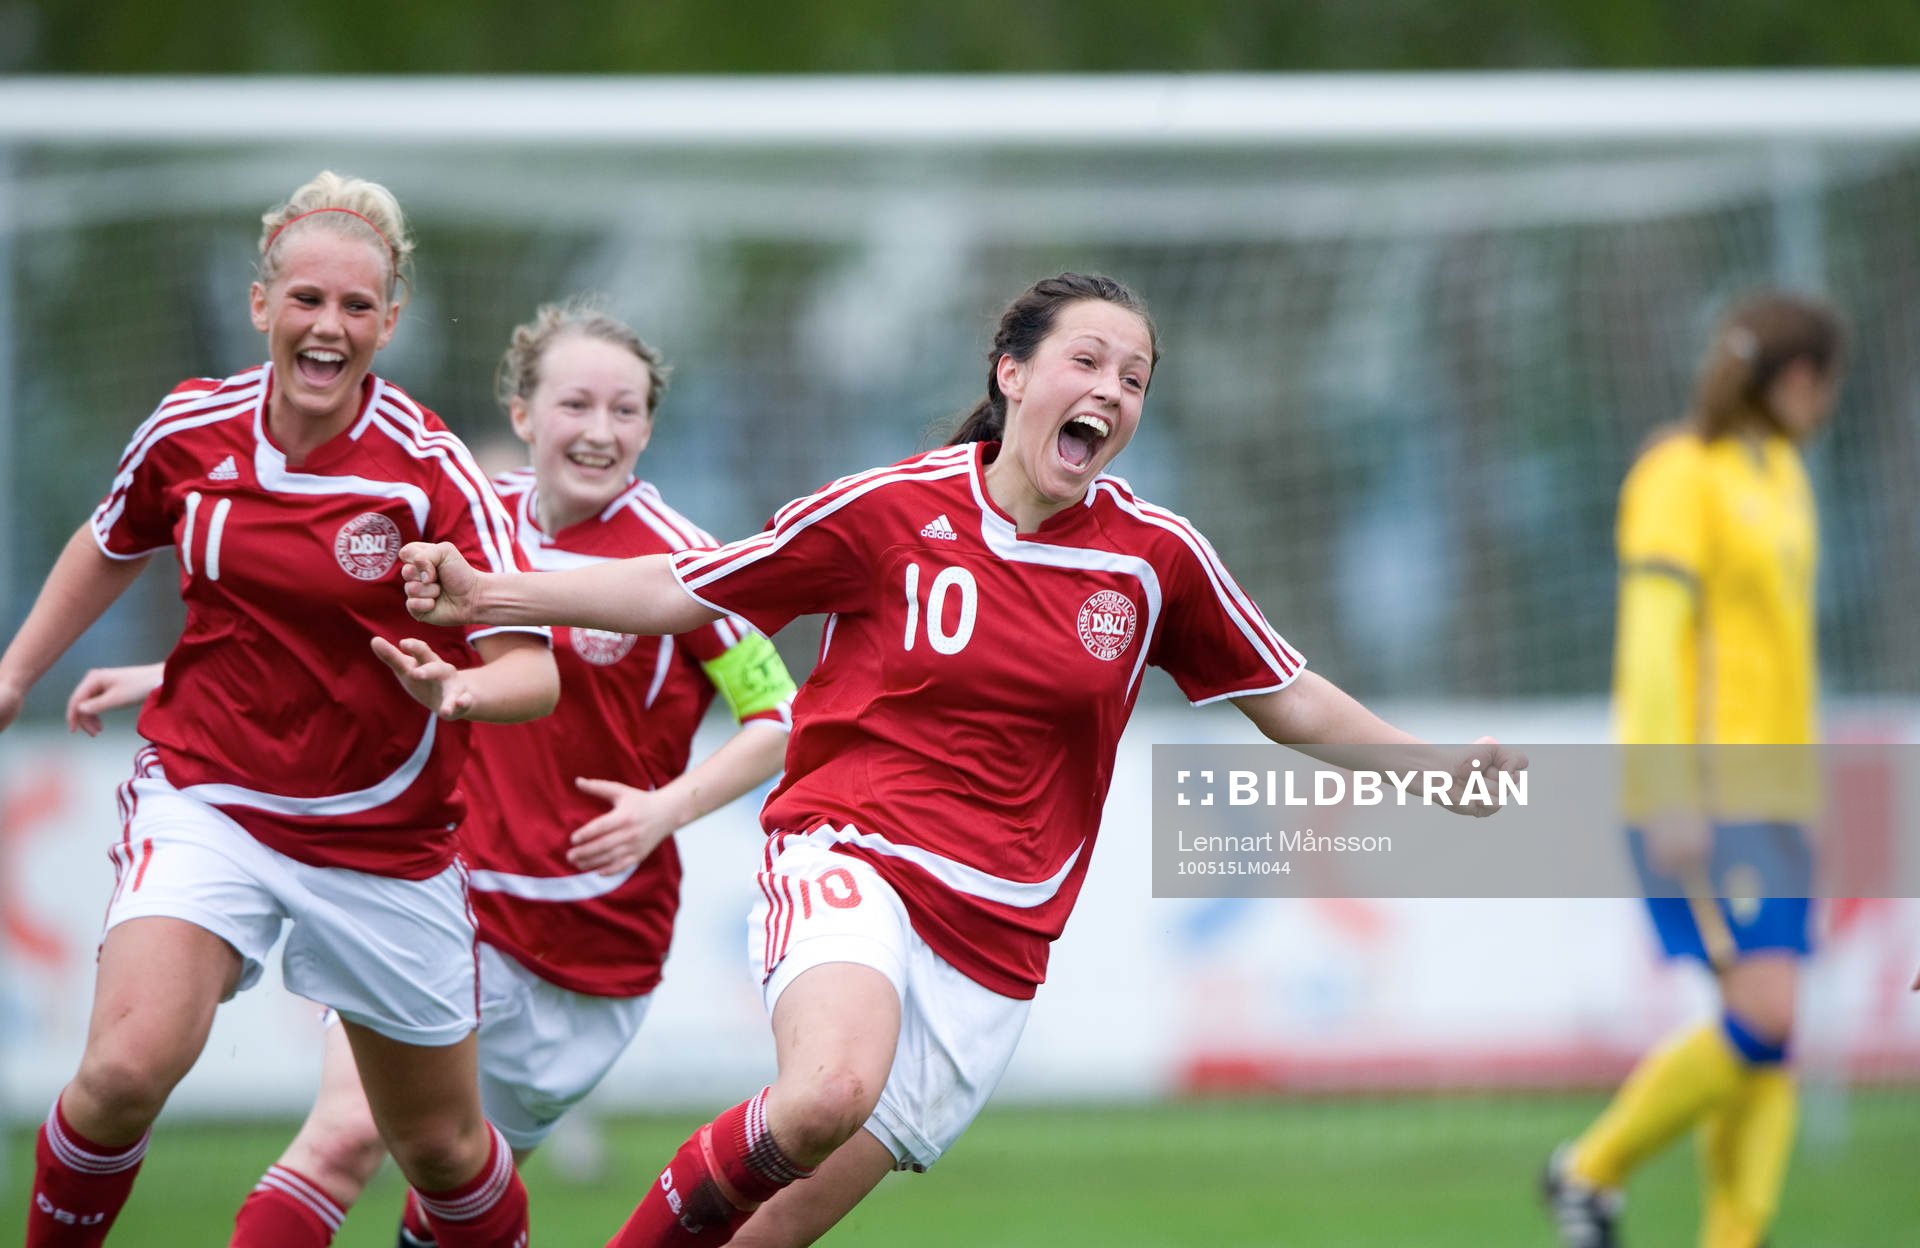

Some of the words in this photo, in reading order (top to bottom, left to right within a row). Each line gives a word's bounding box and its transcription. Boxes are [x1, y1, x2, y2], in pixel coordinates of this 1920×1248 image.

[182, 491, 232, 581] 11
[349, 533, 388, 555] DBU
[920, 528, 958, 541] adidas
[904, 562, 978, 656] 10
[1080, 607, 1095, 649] DANSK
[1092, 613, 1127, 636] DBU
[799, 867, 863, 920] 10
[37, 1191, 105, 1225] DBU
